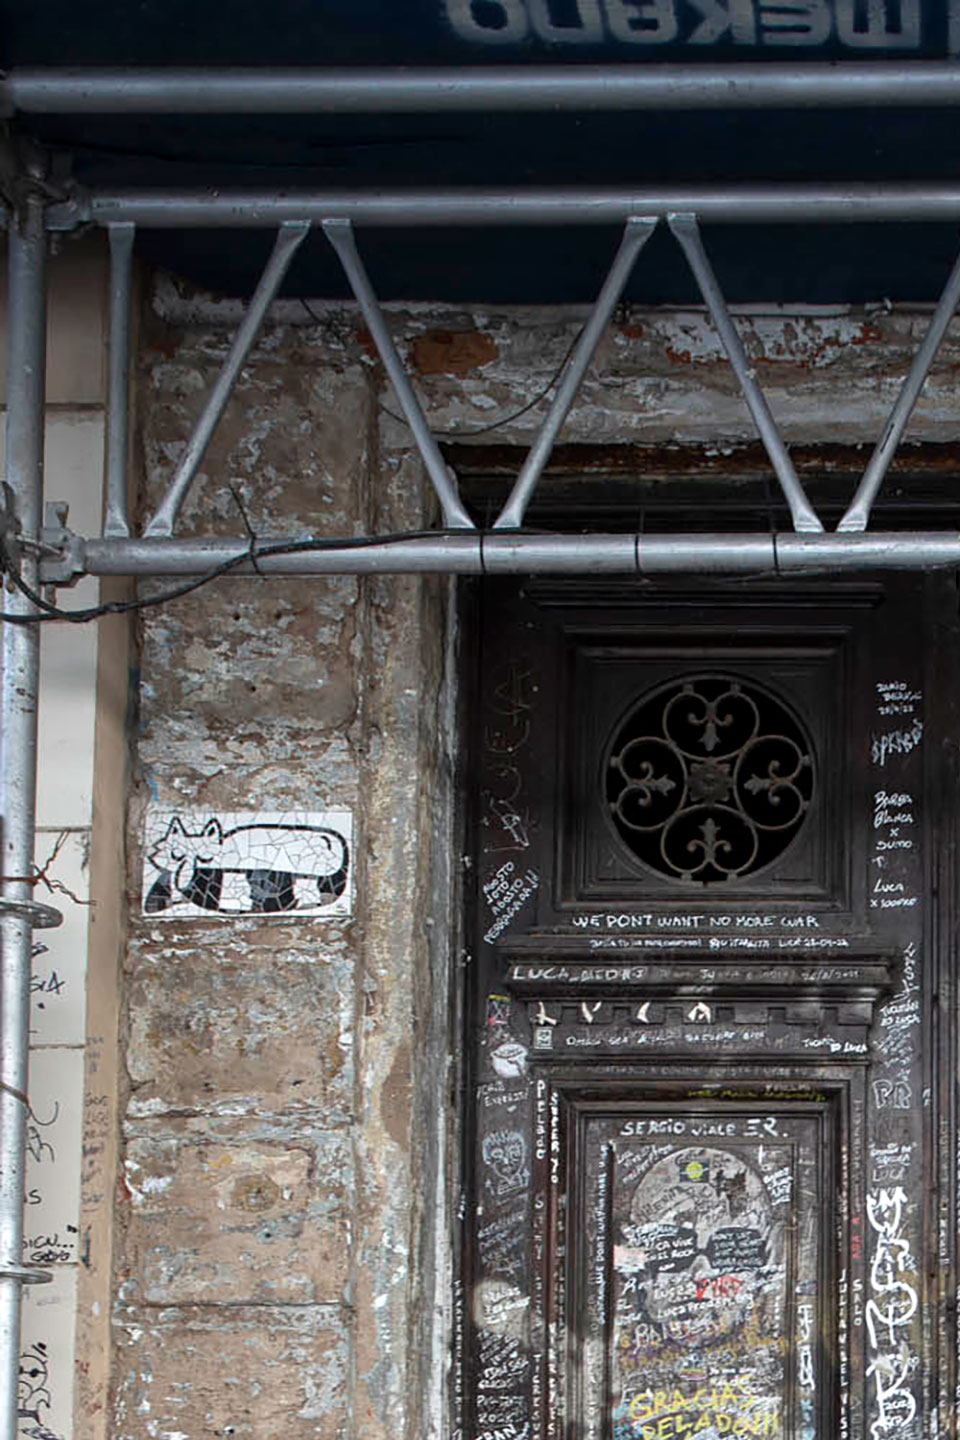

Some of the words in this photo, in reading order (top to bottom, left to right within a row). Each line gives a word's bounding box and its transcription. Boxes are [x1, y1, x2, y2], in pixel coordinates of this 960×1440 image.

[657, 916, 703, 928] WANT
[710, 916, 732, 928] NO
[735, 915, 774, 928] MORE
[620, 1118, 686, 1137] SERGIO
